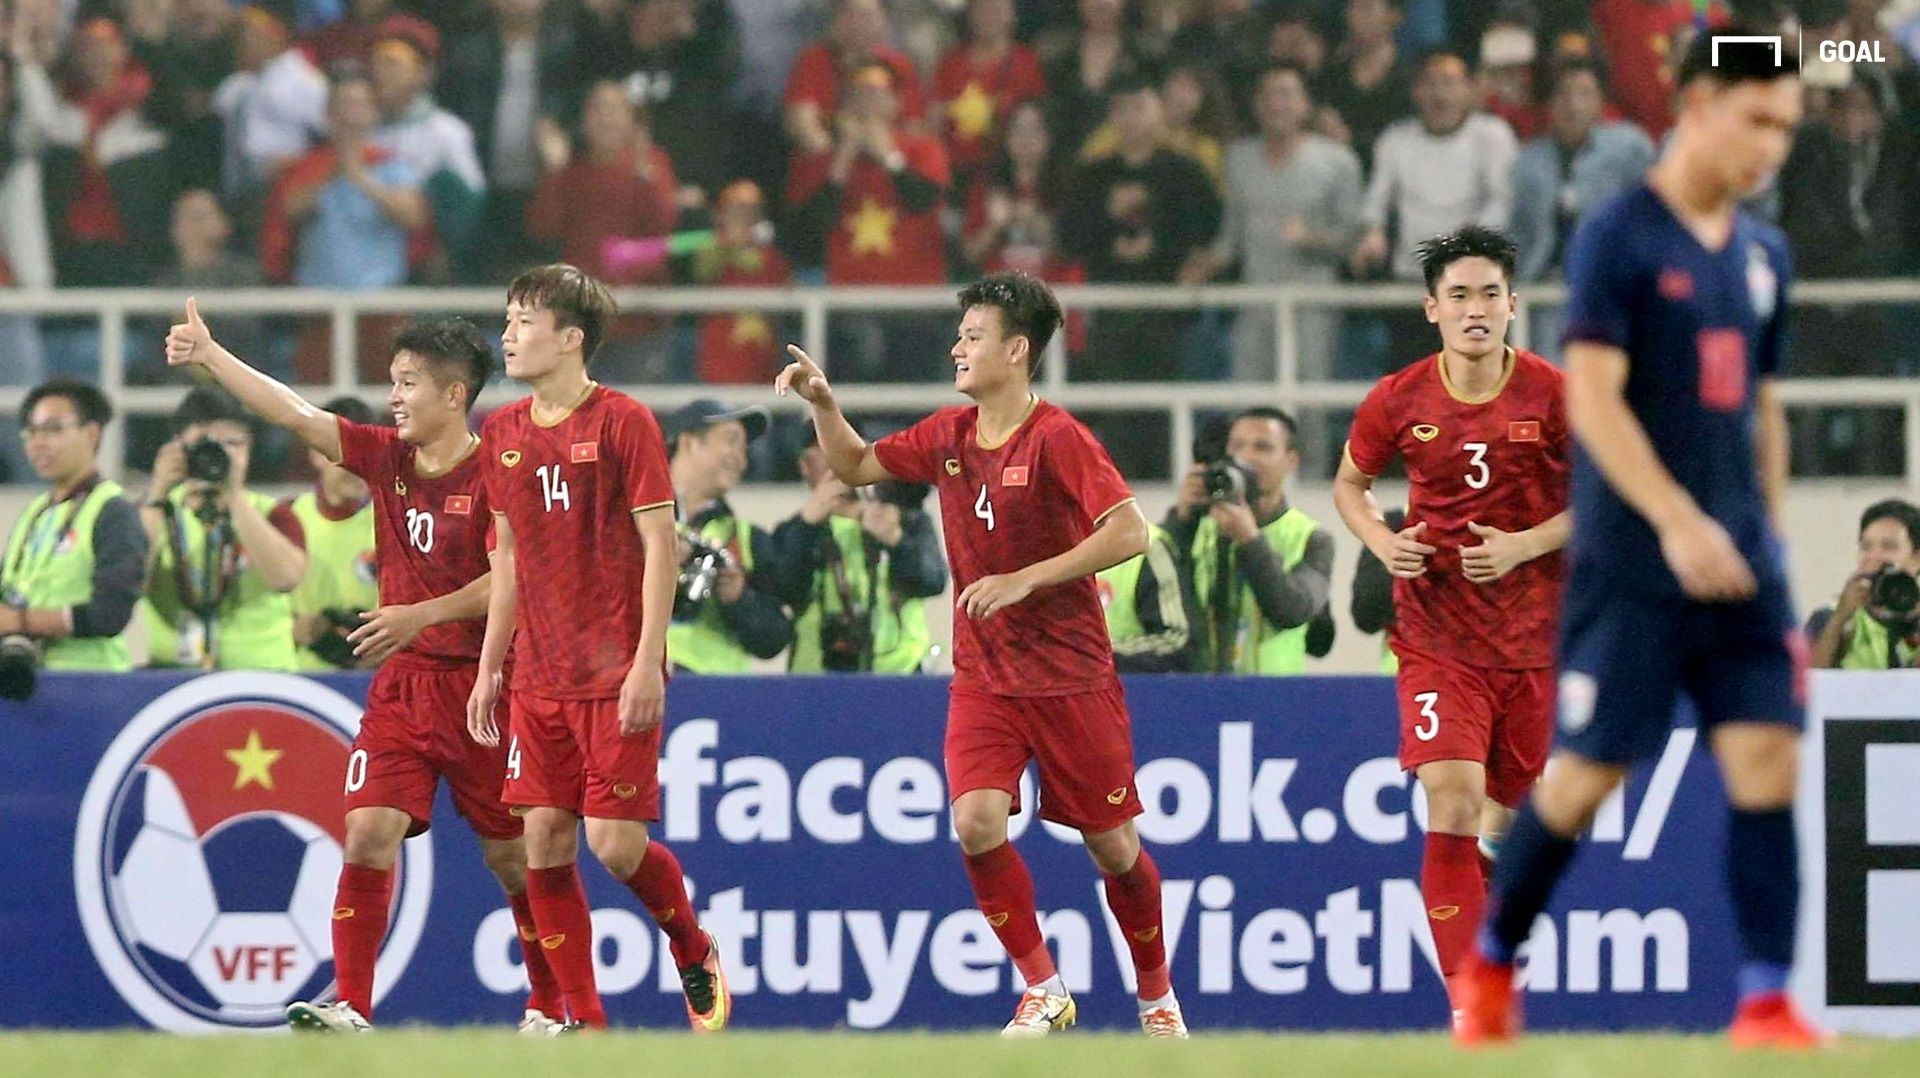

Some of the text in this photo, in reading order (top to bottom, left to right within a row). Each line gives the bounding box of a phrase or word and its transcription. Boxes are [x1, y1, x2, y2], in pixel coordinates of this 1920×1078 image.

[536, 464, 571, 512] 14
[1462, 442, 1490, 489] 3
[405, 508, 434, 553] 10
[974, 483, 995, 531] 4
[1413, 691, 1440, 741] 3
[212, 946, 296, 982] VFF
